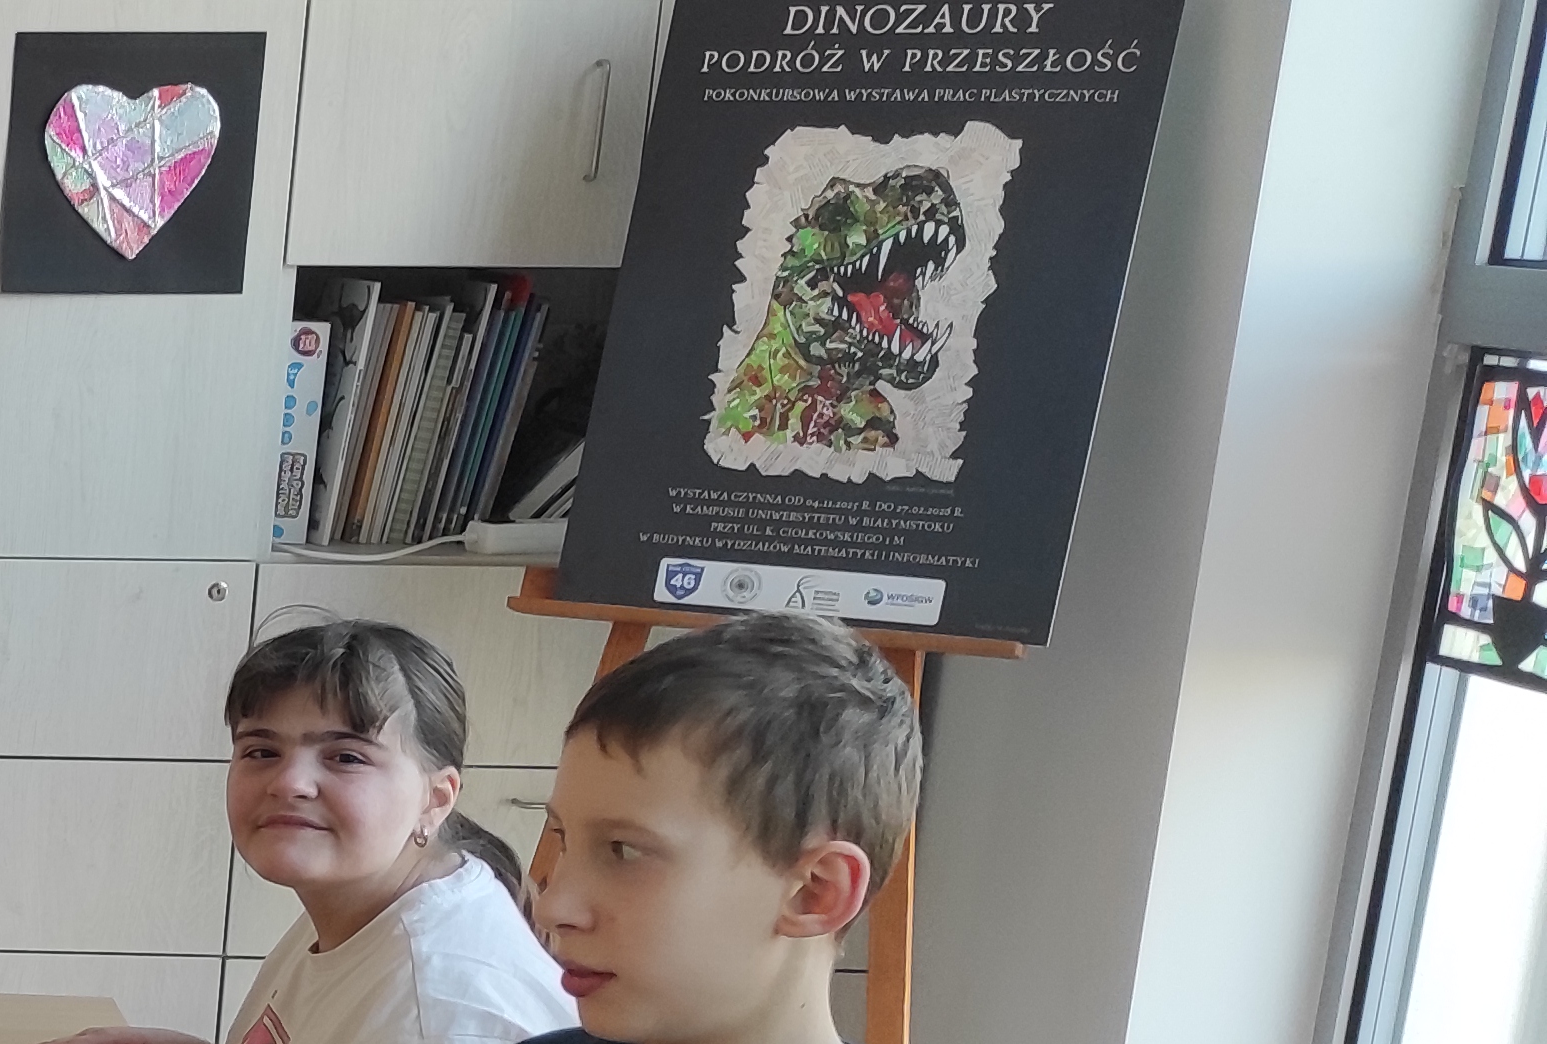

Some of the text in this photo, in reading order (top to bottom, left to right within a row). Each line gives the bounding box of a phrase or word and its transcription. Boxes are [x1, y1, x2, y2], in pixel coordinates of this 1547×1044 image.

[782, 3, 1054, 35] DINOZAURY
[700, 39, 1141, 73] PODRÓŻ W PRZESZŁOŚĆ
[703, 87, 1119, 103] POKONKURSOWA WYSTAWA PRAC PLASTYCZNYCH
[668, 487, 728, 501] WYSTAWA
[731, 492, 782, 505] CZYNNA
[785, 495, 804, 506] OD
[875, 501, 895, 512] DO
[672, 503, 954, 533] W KAMPUSIE UNIWERSYTETU W BIAŁYMSTOKU
[710, 522, 741, 534] PRZY
[893, 535, 905, 546] M
[639, 532, 650, 542] W
[652, 534, 711, 547] BUDYNKU
[715, 538, 791, 553] WYDZIAŁÓW
[793, 544, 878, 560] MATEMATYKI
[889, 552, 980, 568] INFORMATYKI
[670, 573, 696, 589] 46
